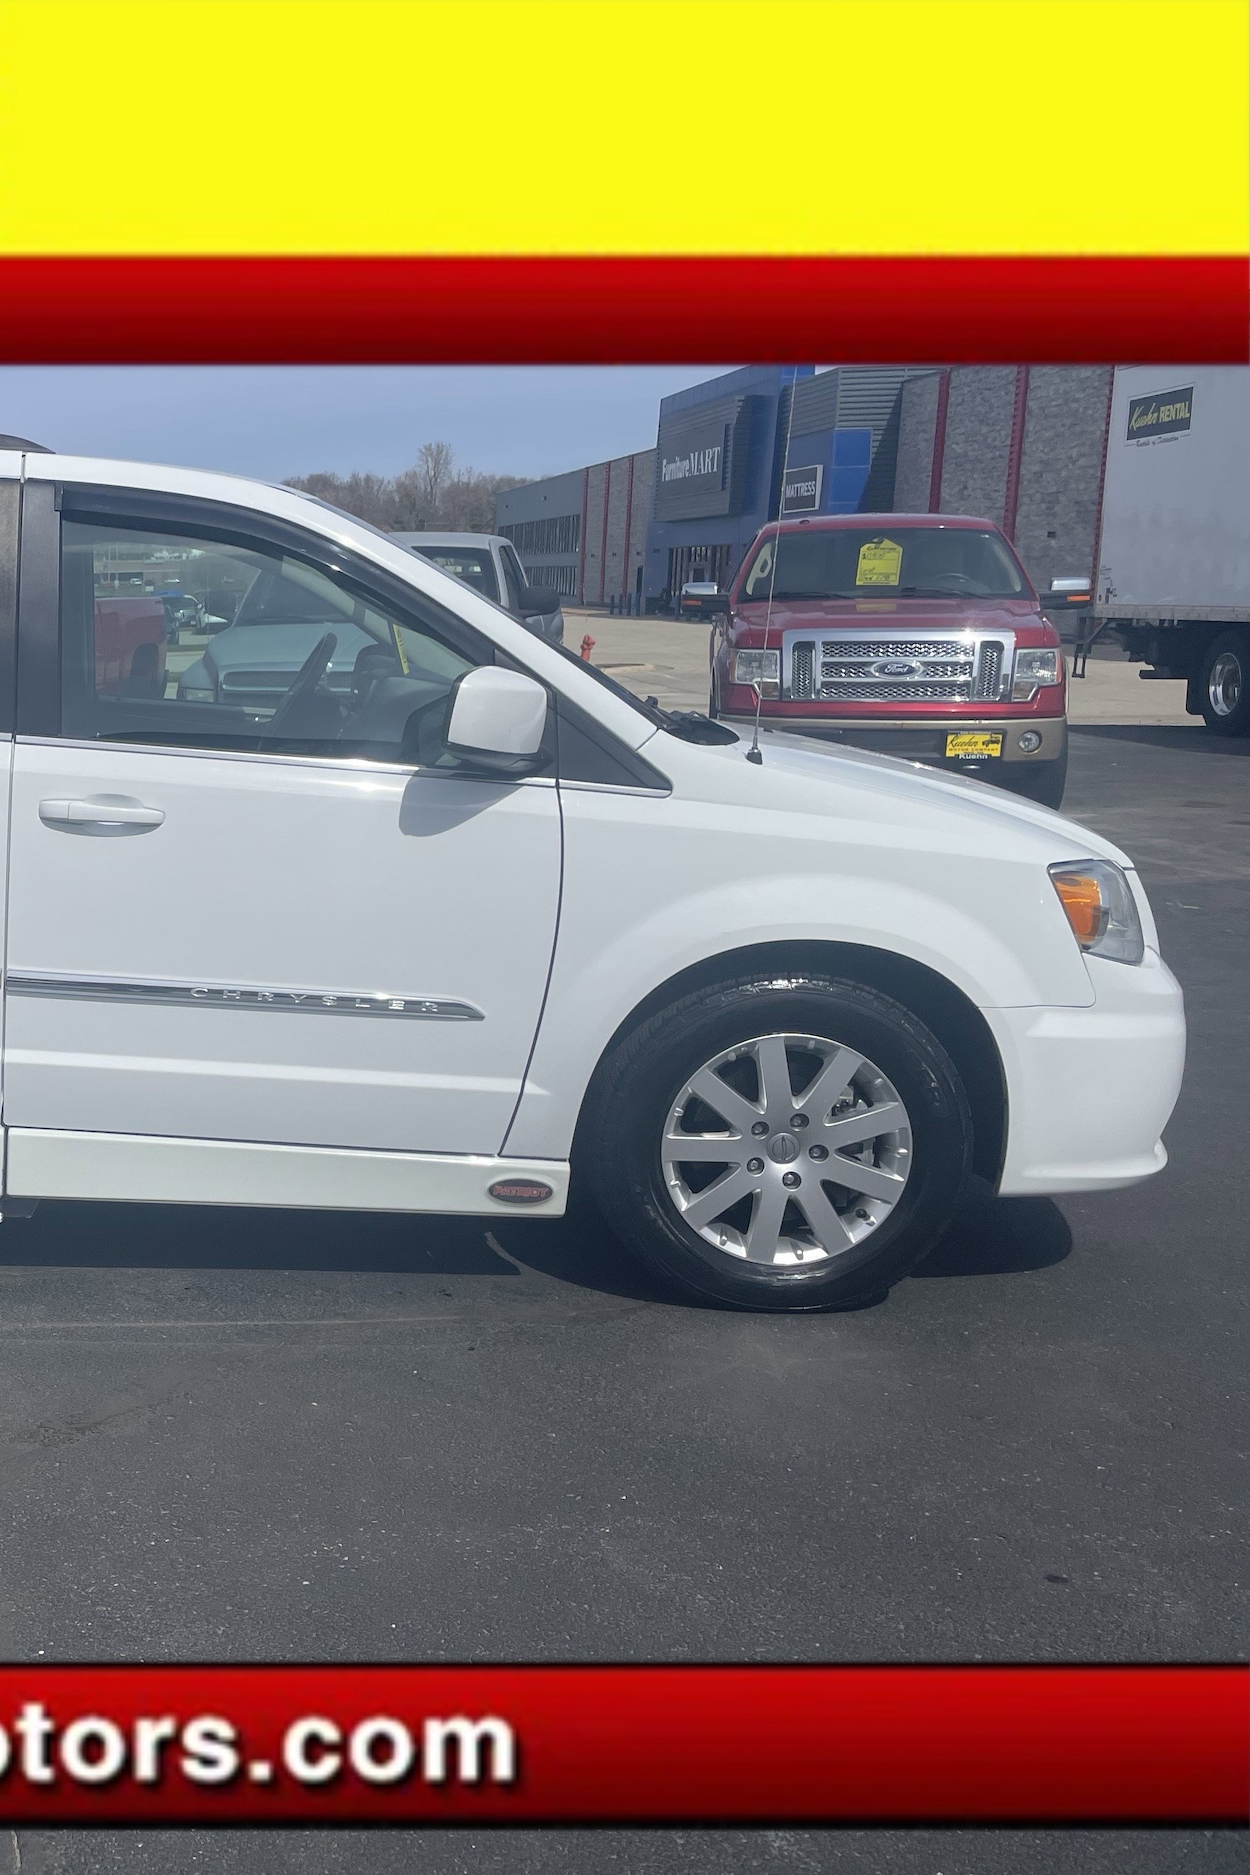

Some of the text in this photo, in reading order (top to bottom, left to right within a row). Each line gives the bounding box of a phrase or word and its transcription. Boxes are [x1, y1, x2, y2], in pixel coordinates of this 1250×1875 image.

[1130, 401, 1190, 431] Kuehn RENTAL
[785, 481, 816, 498] MATTRESS
[884, 663, 909, 673] Ford
[948, 735, 979, 748] Kuehn
[191, 987, 438, 1012] CHRYSLER
